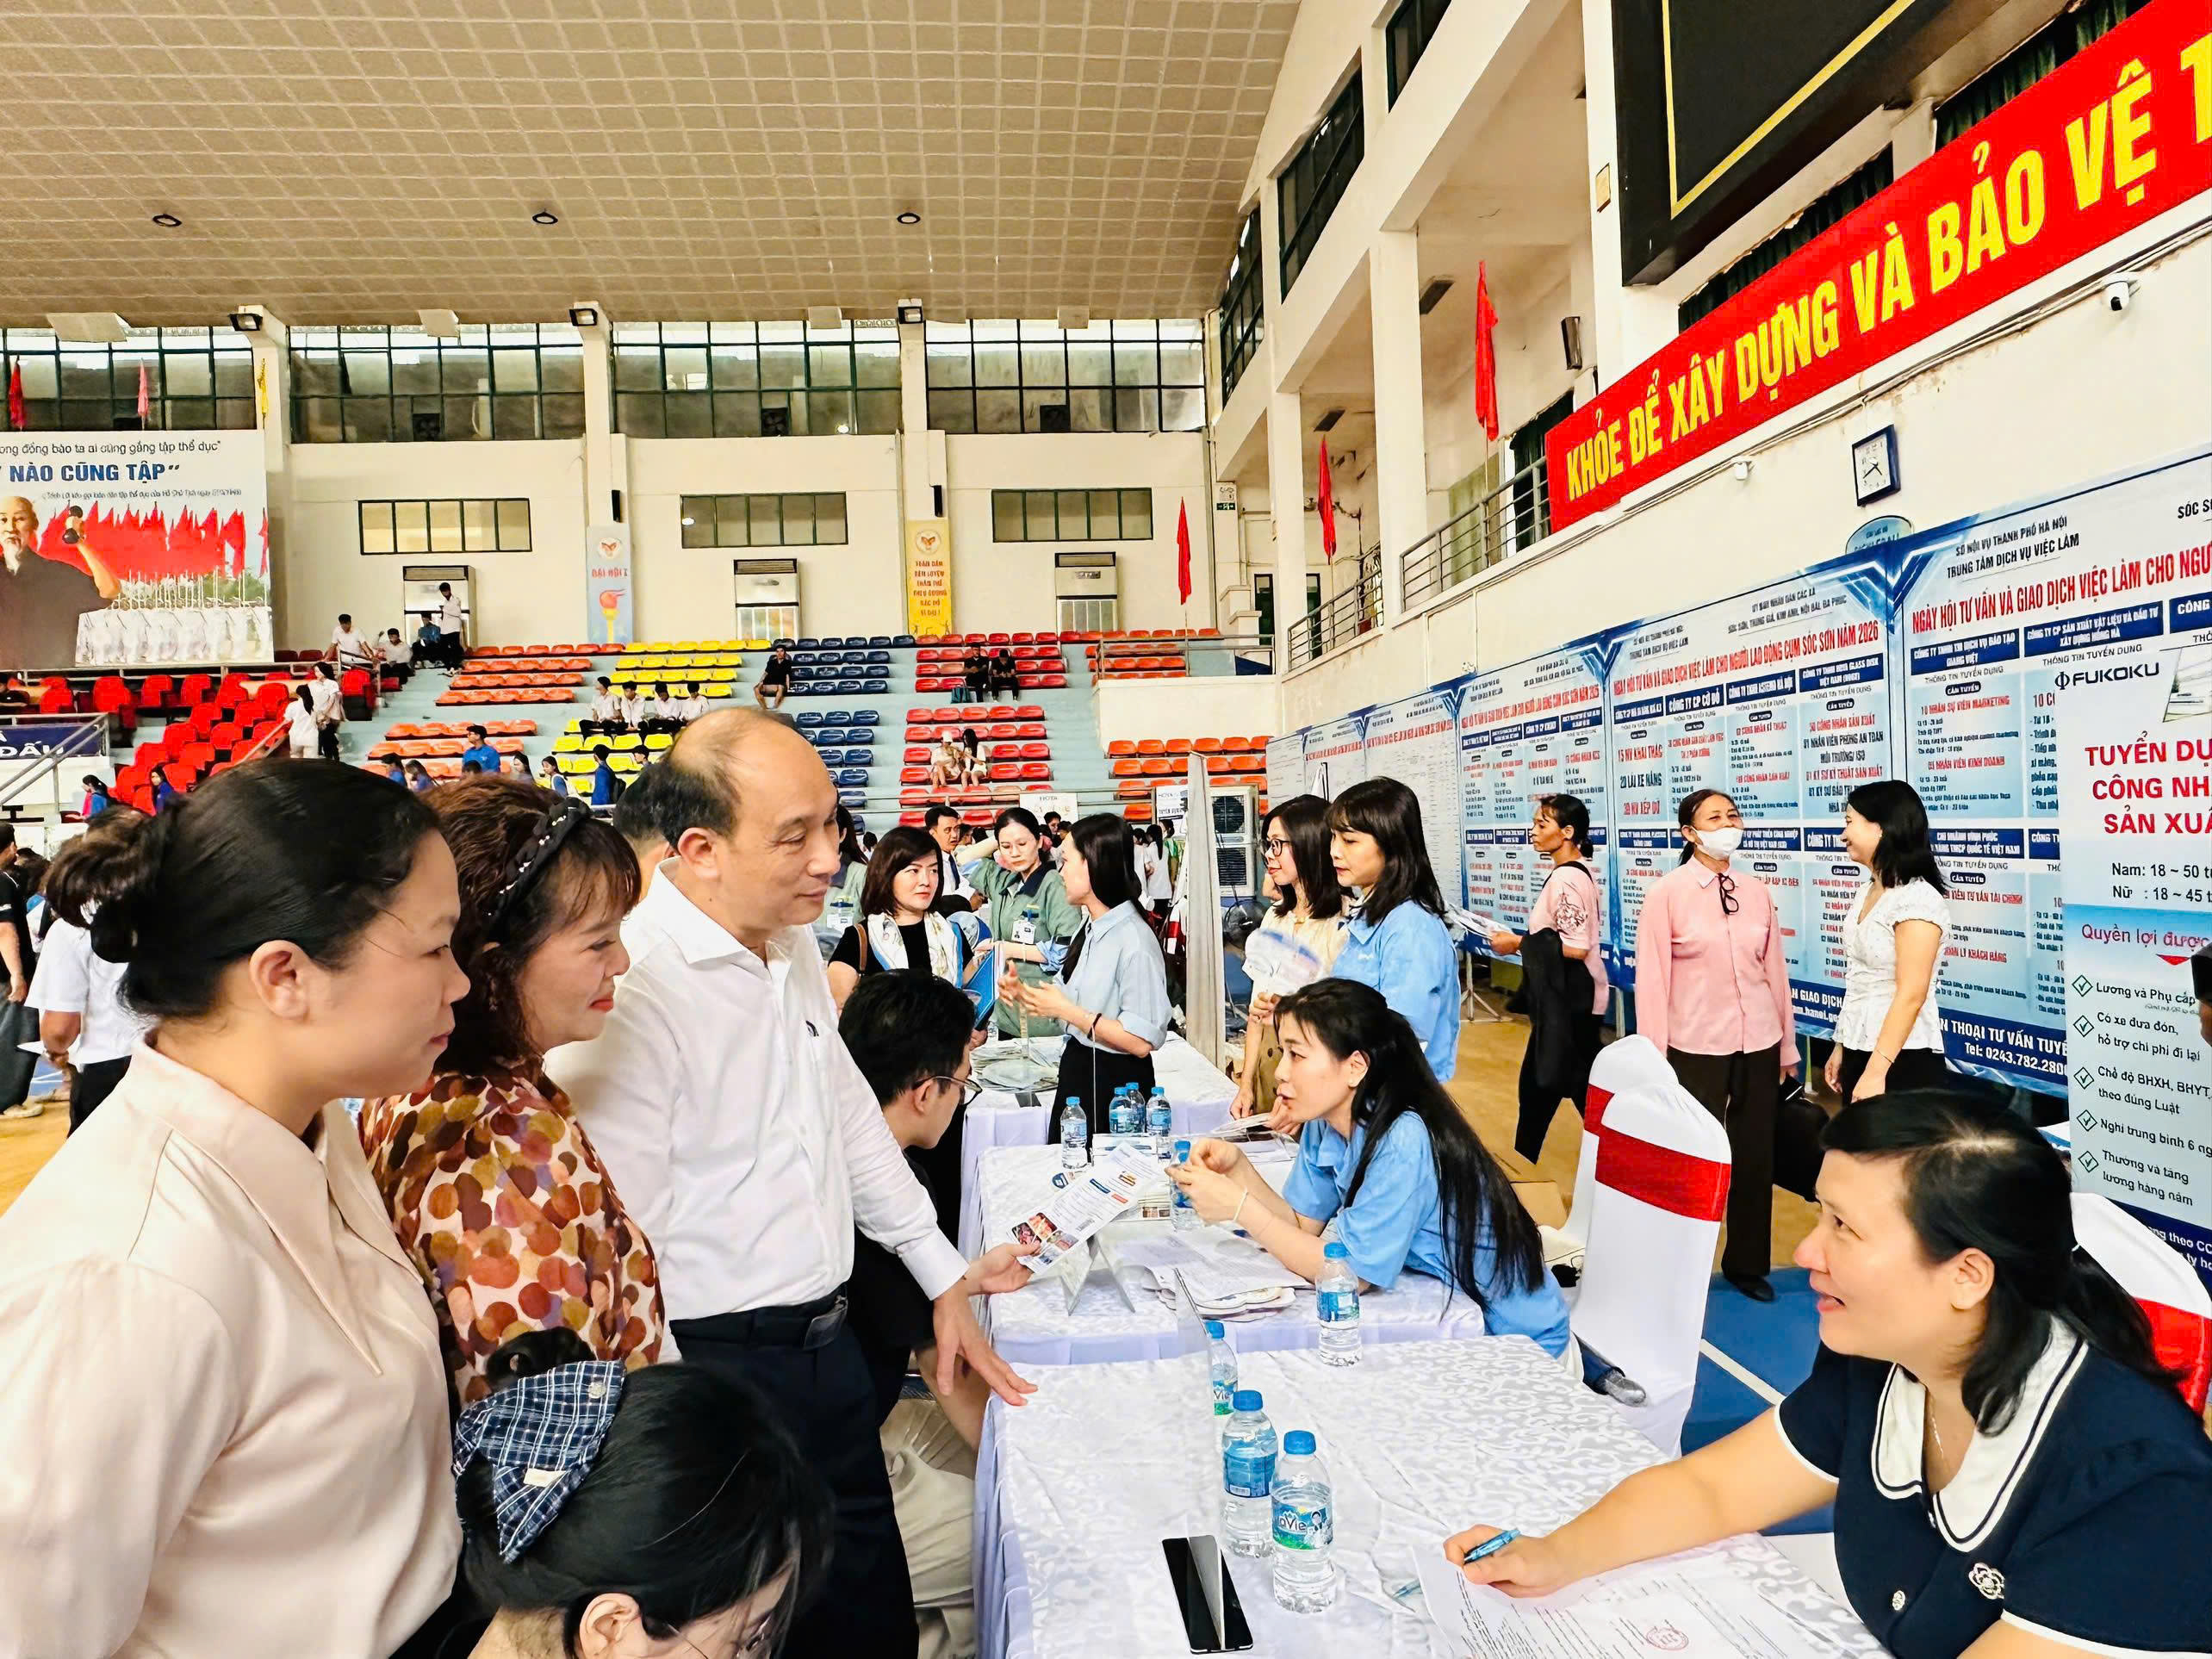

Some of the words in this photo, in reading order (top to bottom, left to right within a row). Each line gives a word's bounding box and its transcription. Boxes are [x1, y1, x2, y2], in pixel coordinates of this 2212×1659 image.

[1567, 408, 1624, 501] KHỎE
[1629, 369, 1662, 465] ĐỂ
[1668, 351, 1724, 443] XÂY
[1736, 281, 1840, 403] DỰNG
[1850, 221, 1915, 334] VÀ
[1928, 140, 2046, 294] BẢO
[2066, 59, 2157, 211] VỆ
[52, 443, 71, 454] bào
[75, 444, 85, 453] ta
[88, 444, 97, 453] ai
[9, 462, 53, 482] NÀO
[61, 462, 119, 482] CŨNG
[2178, 501, 2199, 519] SÓC
[1948, 562, 1973, 579] TRUNG
[1976, 556, 1993, 571] TÂM
[1997, 550, 2017, 567] DỊCH
[2019, 545, 2032, 561] VỤ
[2035, 538, 2055, 557] VIỆC
[2058, 533, 2079, 550] LÀM
[1912, 603, 1937, 634] NGÀY
[1941, 600, 1957, 631] HỘI
[1960, 596, 1973, 624] TƯ
[1975, 587, 1996, 620] VẤN
[1999, 585, 2014, 616] VÀ
[2017, 583, 2042, 612] GIAO
[2047, 575, 2075, 610] DỊCH
[2079, 565, 2107, 602] VIỆC
[2112, 558, 2141, 592] LÀM
[2147, 553, 2174, 585] CHO
[2178, 599, 2209, 615] CÔNG
[1750, 646, 1762, 668] LAO
[1784, 638, 1800, 662] CỤM
[1802, 631, 1817, 656] SÓC
[1819, 628, 1836, 652] SƠN
[1837, 623, 1855, 648] NĂM
[1858, 620, 1879, 644] 2026
[2043, 656, 2069, 666] THÔNG
[2072, 653, 2085, 662] TIN
[2073, 662, 2159, 686] FUKOKU
[2085, 730, 2166, 766] TUYỂN
[2092, 774, 2162, 799] CÔNG
[2104, 805, 2155, 834] SẢN
[2112, 862, 2145, 876] Nam:
[2151, 865, 2165, 877] 18
[2184, 865, 2199, 878] 50
[2113, 885, 2132, 898] Nữ
[2153, 888, 2168, 900] 18
[2186, 889, 2203, 902] 45
[2082, 924, 2130, 944] Quyền
[2137, 929, 2157, 948] lợi
[1800, 990, 1819, 1003] GIAO
[1822, 992, 1842, 1008] DỊCH
[2097, 982, 2131, 998] Lương
[2134, 988, 2147, 998] và
[2150, 990, 2172, 1003] Phụ
[2175, 991, 2196, 1006] cấp
[1951, 1020, 1985, 1041] THOẠI
[1988, 1028, 2005, 1042] TƯ
[2007, 1029, 2033, 1049] VẤN
[2097, 1012, 2110, 1023] Có
[2114, 1016, 2126, 1025] xe
[2129, 1017, 2150, 1029] đưa
[2153, 1021, 2178, 1035] đón,
[1965, 1042, 1983, 1057] Tel:
[2114, 1037, 2129, 1050] trợ
[2133, 1041, 2149, 1052] chi
[2172, 1047, 2183, 1059] đi
[2187, 1049, 2200, 1062] lại
[2121, 1072, 2134, 1084] độ
[2138, 1074, 2173, 1091] BHXH,
[2098, 1088, 2121, 1101] theo
[2124, 1093, 2152, 1110] đúng
[2155, 1099, 2179, 1115] Luật
[2128, 1126, 2156, 1143] trung
[2188, 1140, 2195, 1150] 6
[2147, 1164, 2160, 1175] và
[2164, 1167, 2189, 1185] tăng
[2103, 1171, 2134, 1191] lương
[2138, 1181, 2165, 1200] hàng
[2168, 1191, 2193, 1206] năm
[2169, 1233, 2193, 1247] theo
